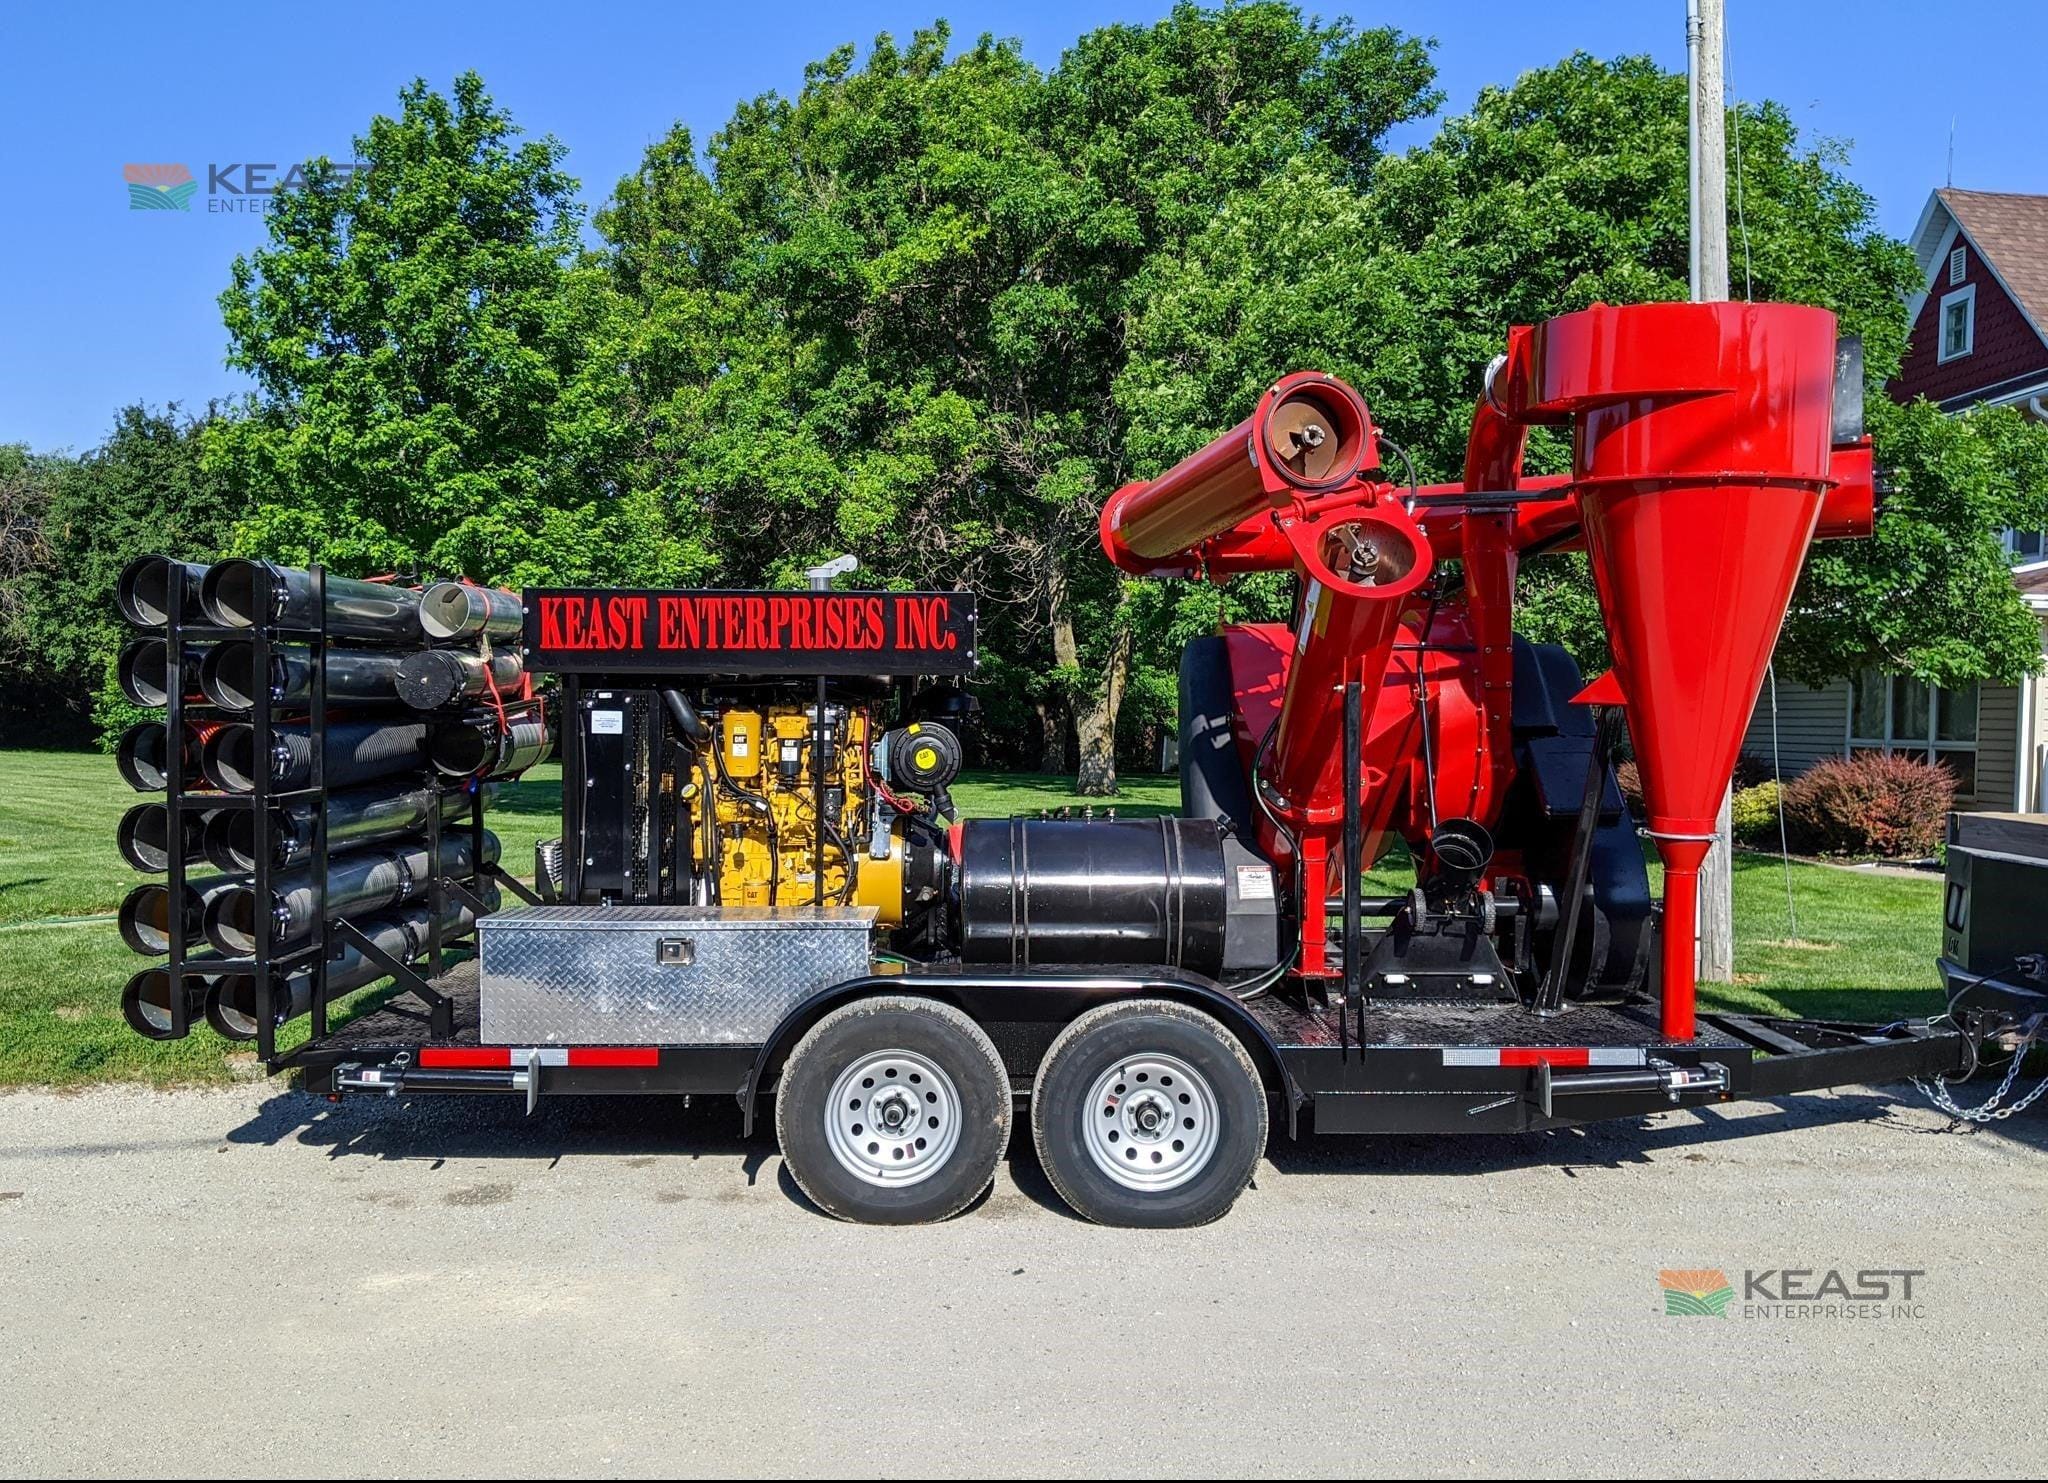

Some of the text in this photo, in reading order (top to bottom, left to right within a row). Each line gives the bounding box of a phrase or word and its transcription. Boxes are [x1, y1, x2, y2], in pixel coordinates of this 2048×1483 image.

[539, 597, 957, 651] KEAST ENTERPRISES INC.
[746, 891, 758, 899] CAT
